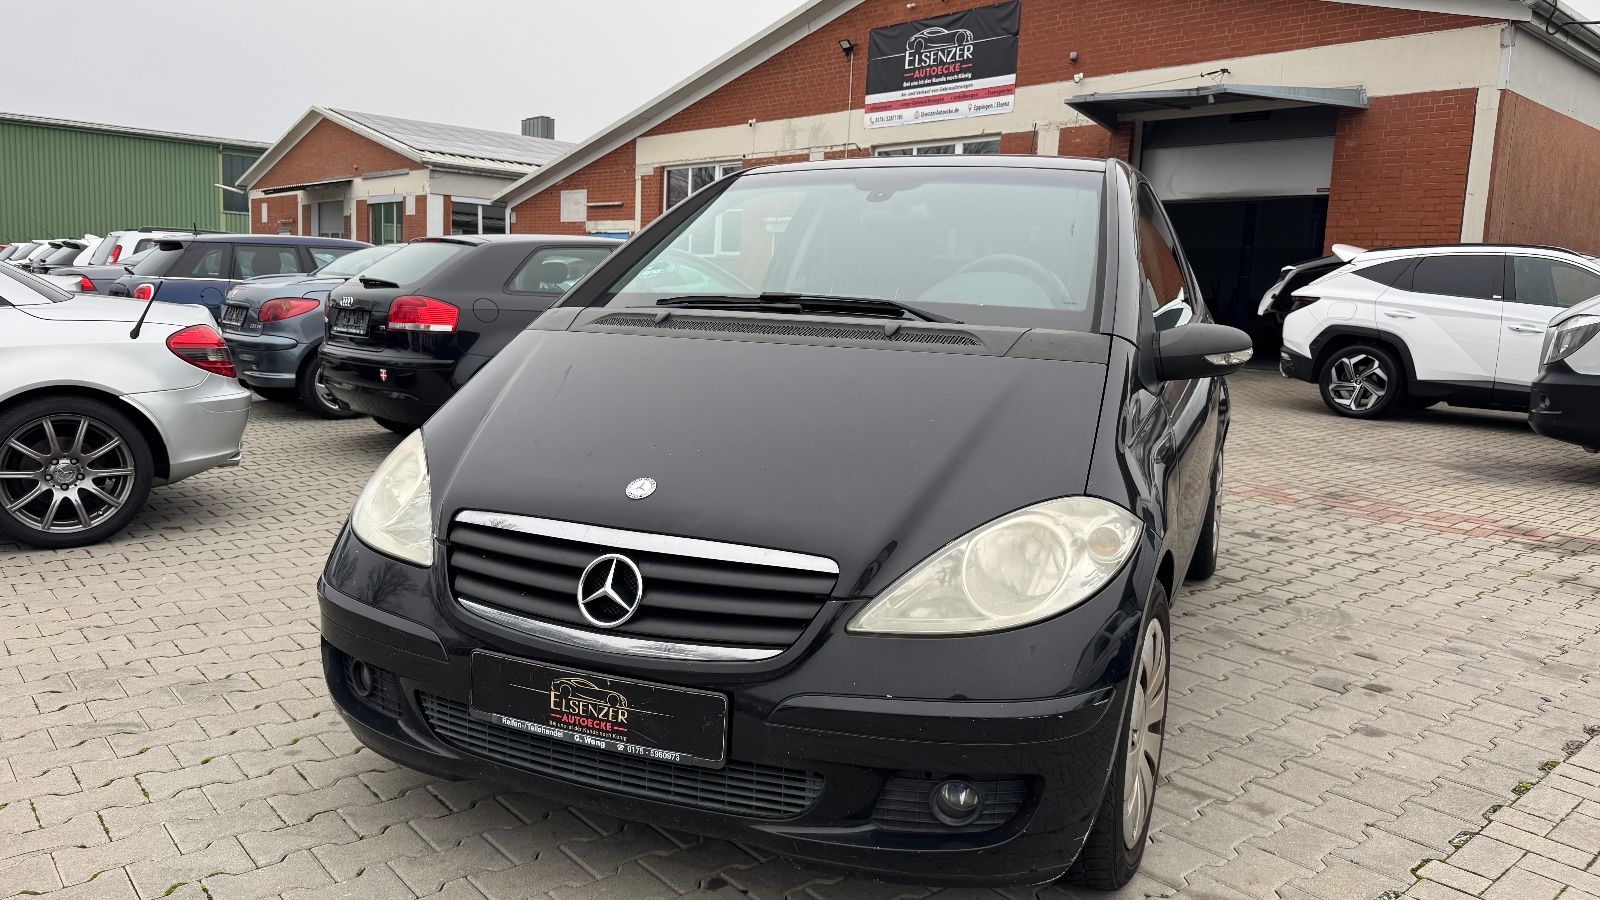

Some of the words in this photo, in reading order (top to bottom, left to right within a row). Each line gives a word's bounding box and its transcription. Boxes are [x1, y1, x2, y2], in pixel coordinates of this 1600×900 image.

[905, 45, 973, 69] ELSENZER
[914, 63, 960, 78] AUTOECKE
[974, 103, 993, 111] Eppingen
[550, 690, 628, 724] ELSENZER
[562, 714, 612, 732] AUTOECKE
